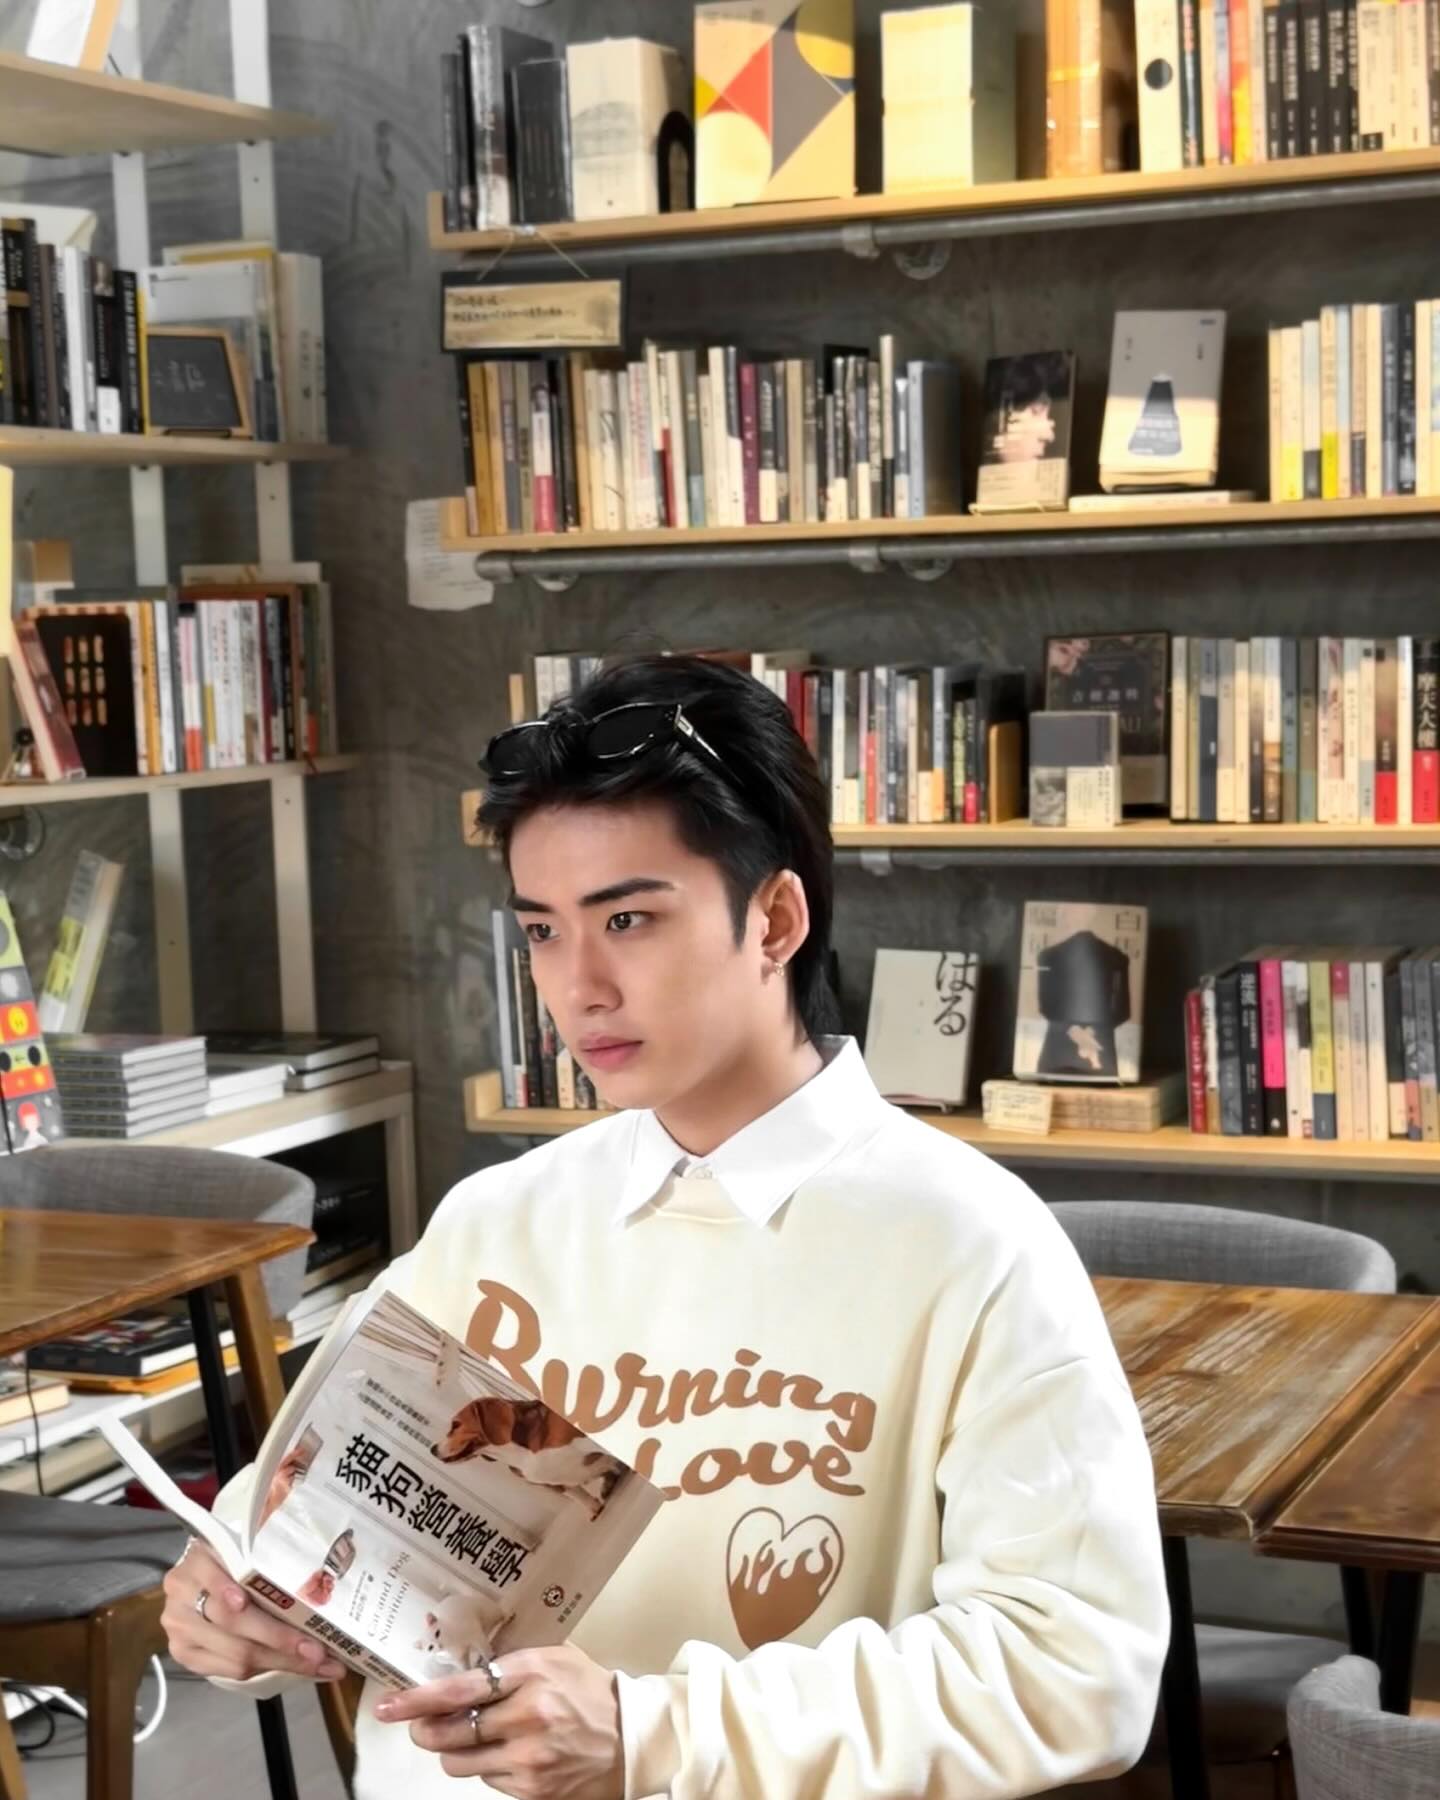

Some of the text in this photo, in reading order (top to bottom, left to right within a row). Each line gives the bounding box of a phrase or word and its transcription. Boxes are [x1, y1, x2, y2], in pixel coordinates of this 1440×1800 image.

[934, 952, 976, 1036] はる
[466, 1279, 877, 1452] Burning
[335, 1433, 529, 1587] 貓狗營養學
